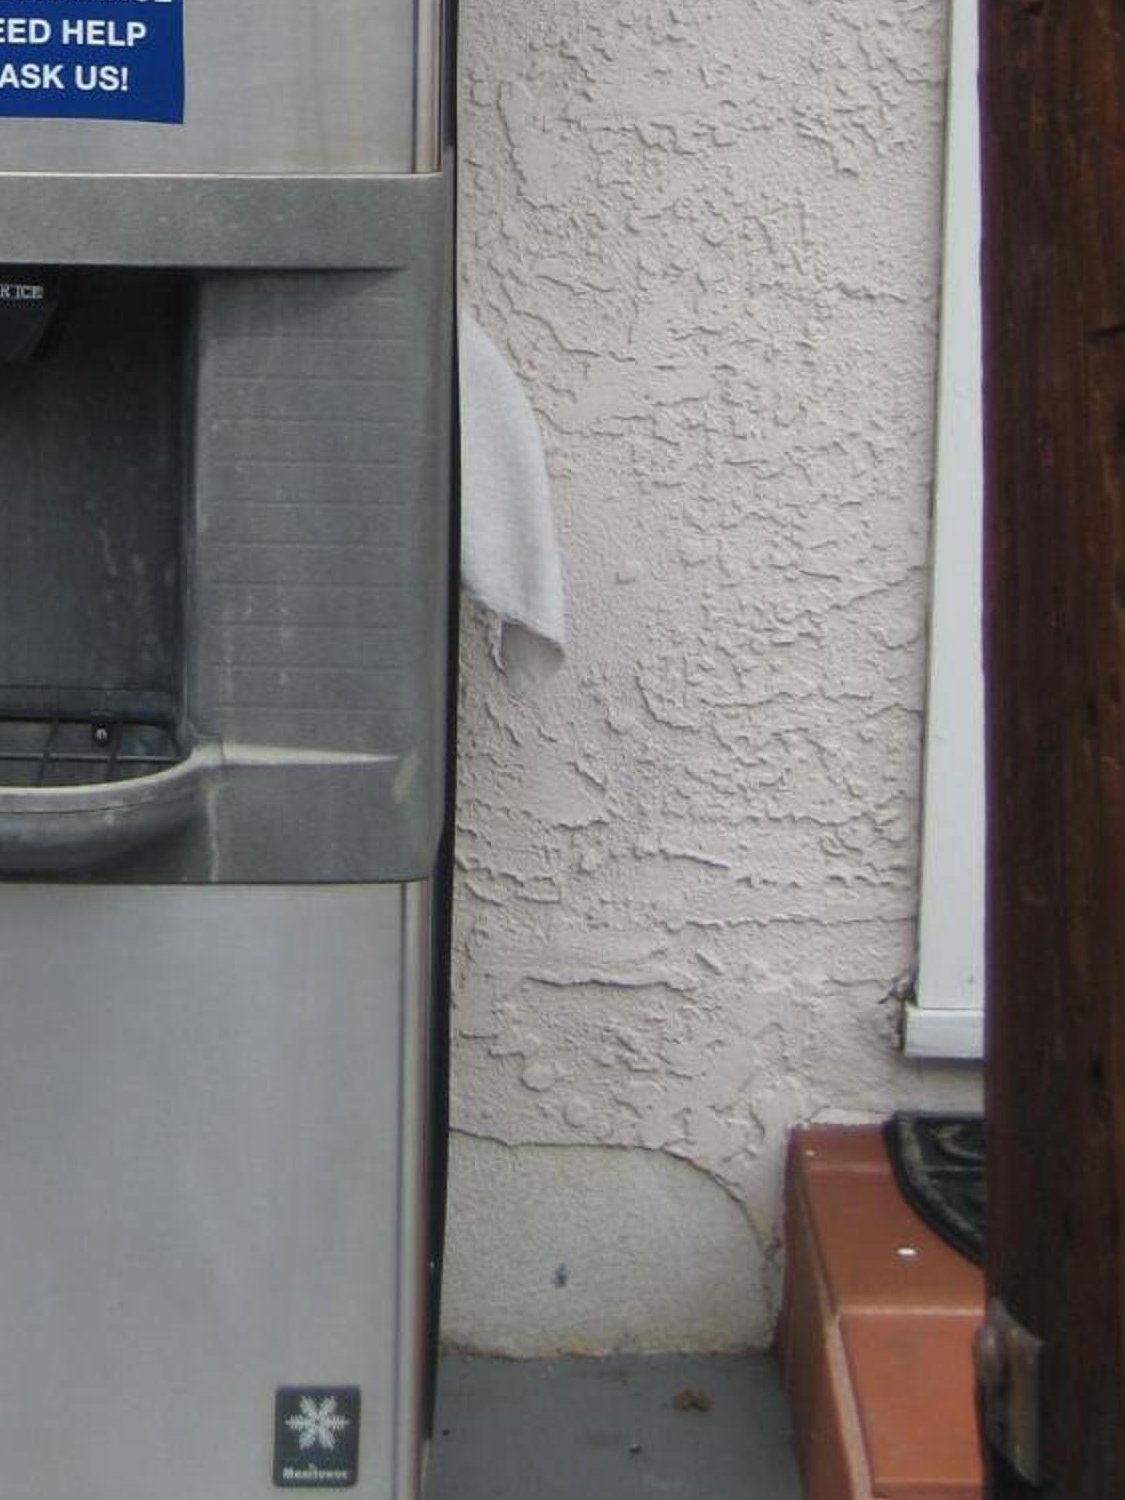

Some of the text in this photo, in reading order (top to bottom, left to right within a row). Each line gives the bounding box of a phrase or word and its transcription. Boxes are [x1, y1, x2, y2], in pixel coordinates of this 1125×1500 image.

[62, 20, 147, 47] HELP
[76, 66, 128, 91] US!
[15, 284, 43, 299] ICE
